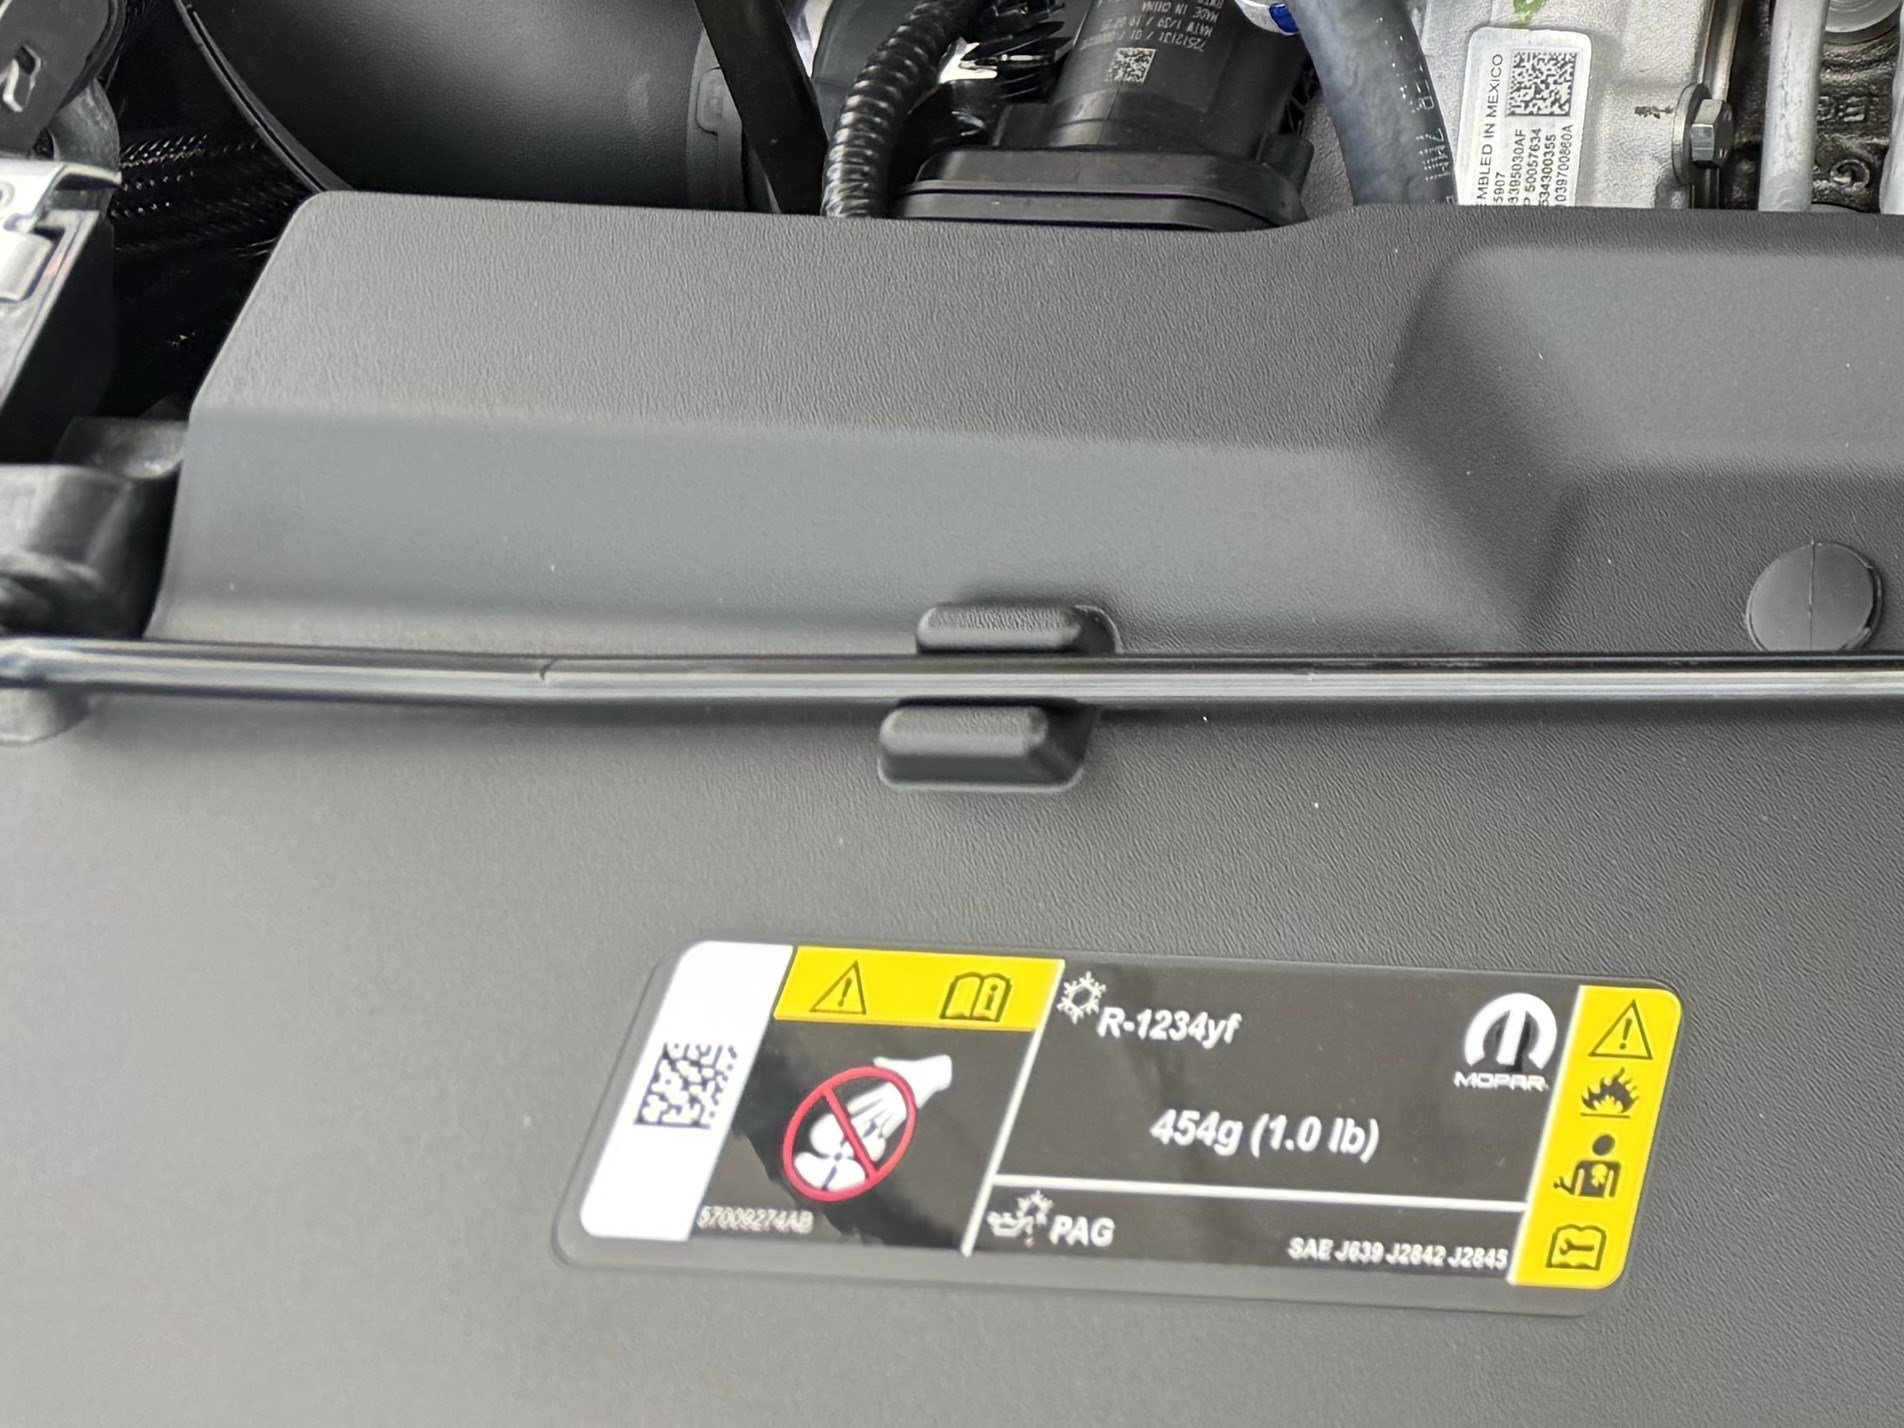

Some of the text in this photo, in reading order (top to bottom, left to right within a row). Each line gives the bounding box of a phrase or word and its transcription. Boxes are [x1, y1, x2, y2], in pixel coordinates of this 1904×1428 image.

[1483, 53, 1504, 117] MEXICO
[1482, 122, 1495, 137] IN
[1523, 127, 1542, 192] 50057634
[1097, 1007, 1242, 1050] R-1234yf
[1454, 1071, 1546, 1092] MOPAR
[1150, 1109, 1380, 1163] 454g (1.0 lb)
[1049, 1216, 1115, 1247] PAG
[1287, 1238, 1332, 1259] SAE
[1334, 1240, 1383, 1263] J639
[1386, 1242, 1446, 1267] J2842
